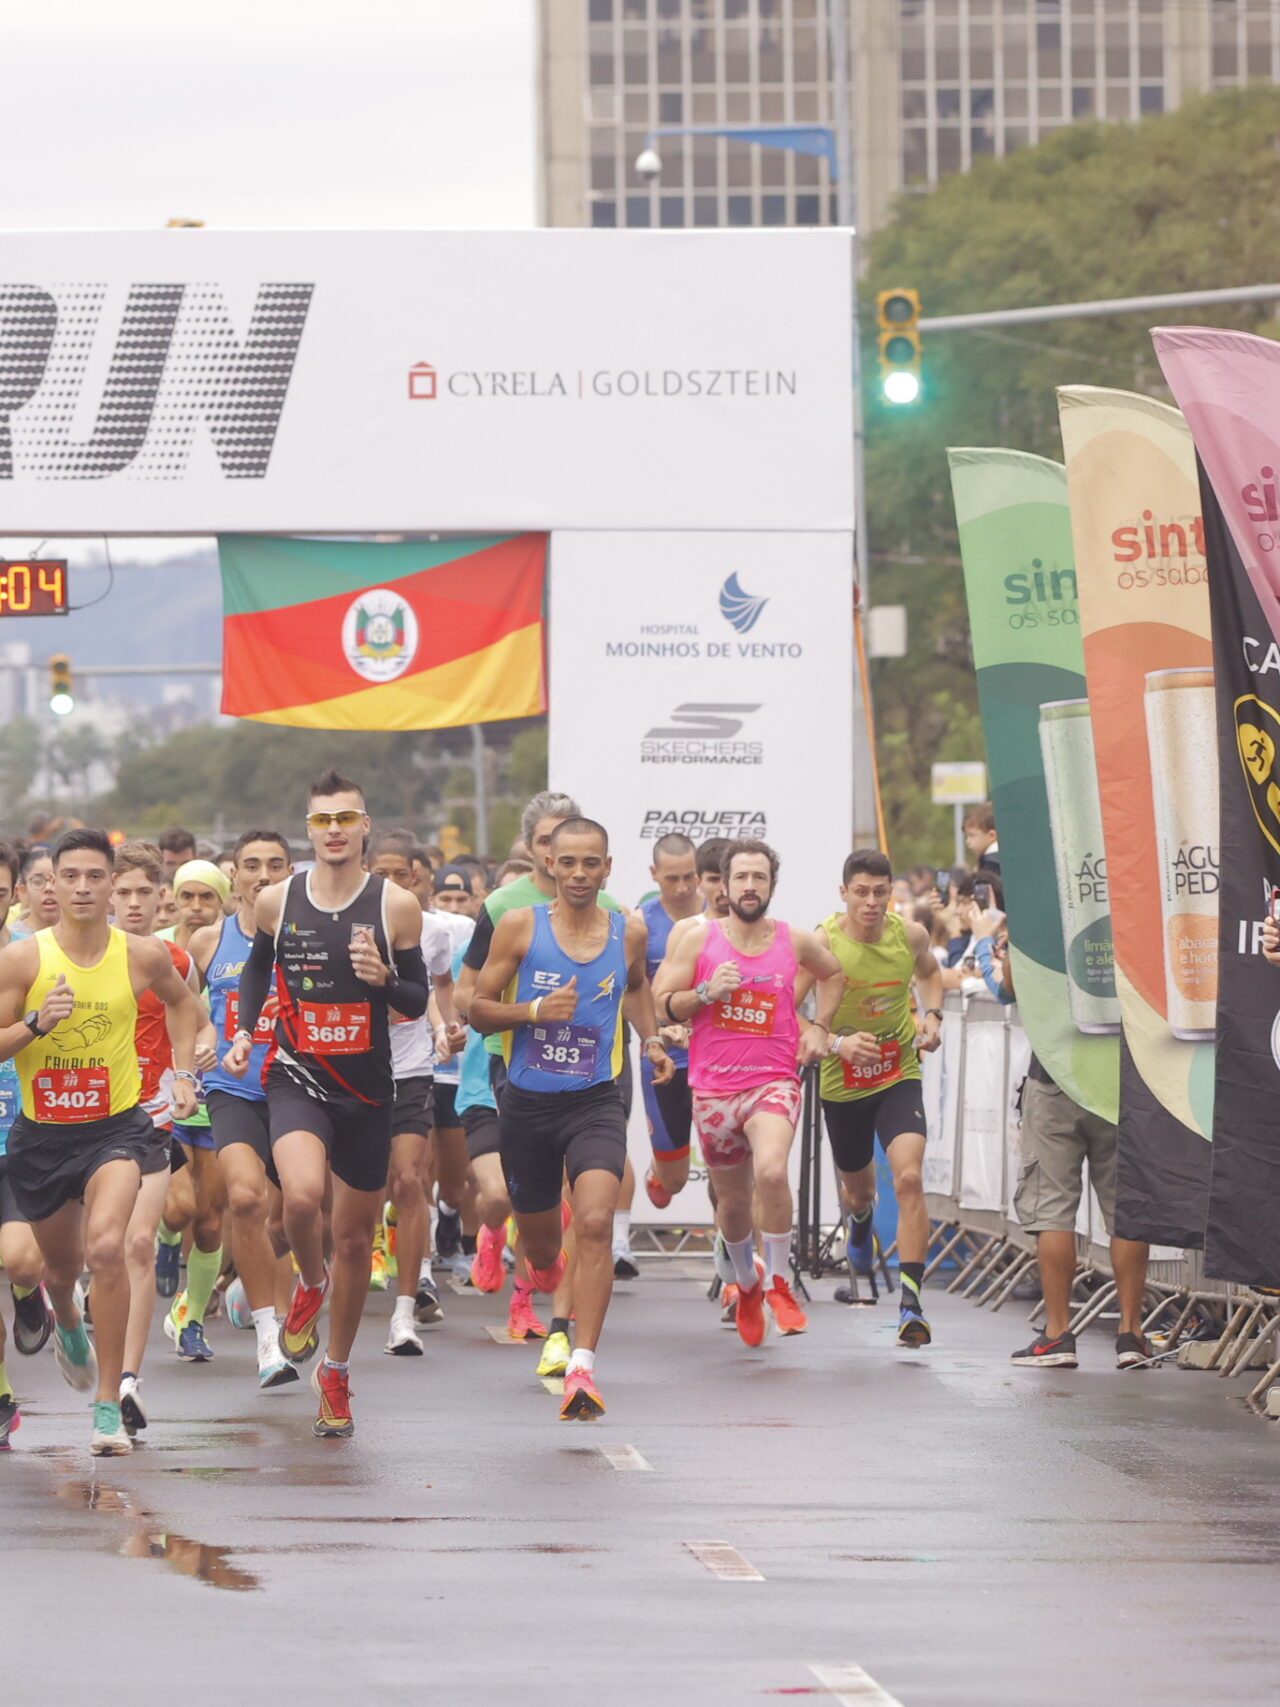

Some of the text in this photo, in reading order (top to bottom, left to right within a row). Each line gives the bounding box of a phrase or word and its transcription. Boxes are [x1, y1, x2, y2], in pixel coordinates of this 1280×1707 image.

[446, 370, 798, 397] CYRELA GOLDSZTEIN
[1117, 571, 1149, 590] os
[639, 624, 700, 636] HOSPITAL
[605, 641, 804, 659] MOINHOS DE VENTO
[640, 741, 764, 755] SKECHERS
[640, 754, 763, 765] PERFORMANCE
[644, 810, 768, 825] PAQUETA
[533, 970, 562, 986] EZ
[720, 1004, 768, 1026] 3359
[306, 1024, 361, 1043] 3687
[541, 1043, 581, 1064] 383
[851, 1060, 893, 1079] 3905
[43, 1090, 101, 1109] 3402
